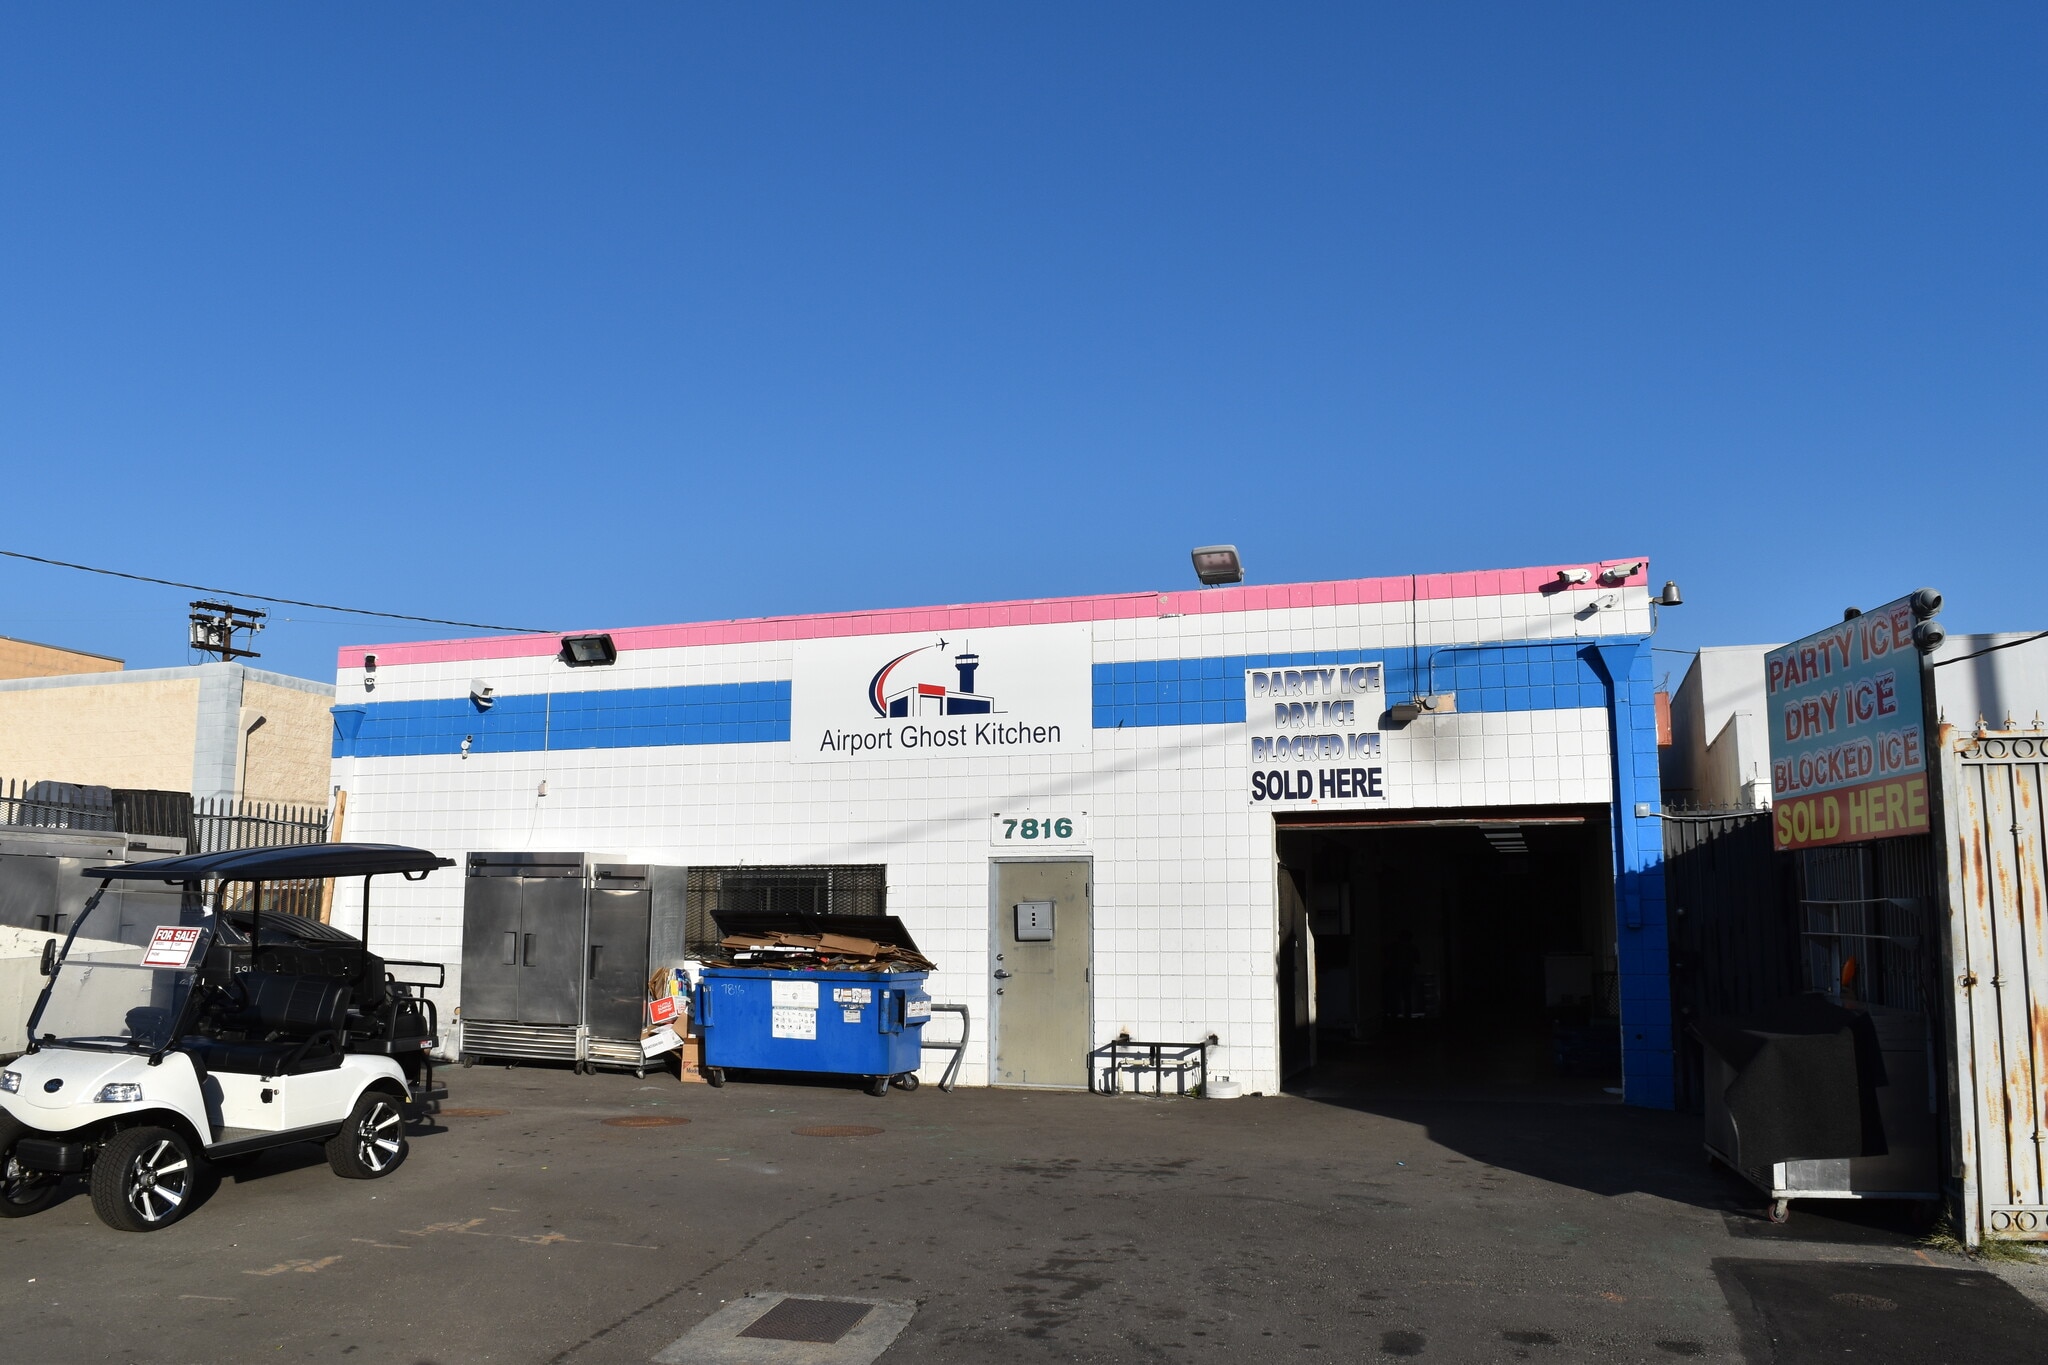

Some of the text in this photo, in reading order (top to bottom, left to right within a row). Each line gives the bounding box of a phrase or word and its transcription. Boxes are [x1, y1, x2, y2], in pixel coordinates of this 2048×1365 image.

[1768, 604, 1913, 693] PARTY ICE
[1252, 666, 1380, 698] PARTY ICE
[1274, 700, 1355, 730] DRY ICE
[1784, 671, 1896, 741] DRY ICE
[819, 721, 1061, 755] Airport Ghost Kitchen
[1251, 732, 1381, 763] BLOCKED ICE
[1774, 728, 1920, 795] BLOCKED ICE
[1252, 767, 1383, 801] SOLD HERE
[1002, 817, 1073, 840] 7816
[1777, 778, 1927, 846] SOLD HERE
[155, 930, 197, 942] FOR SALE
